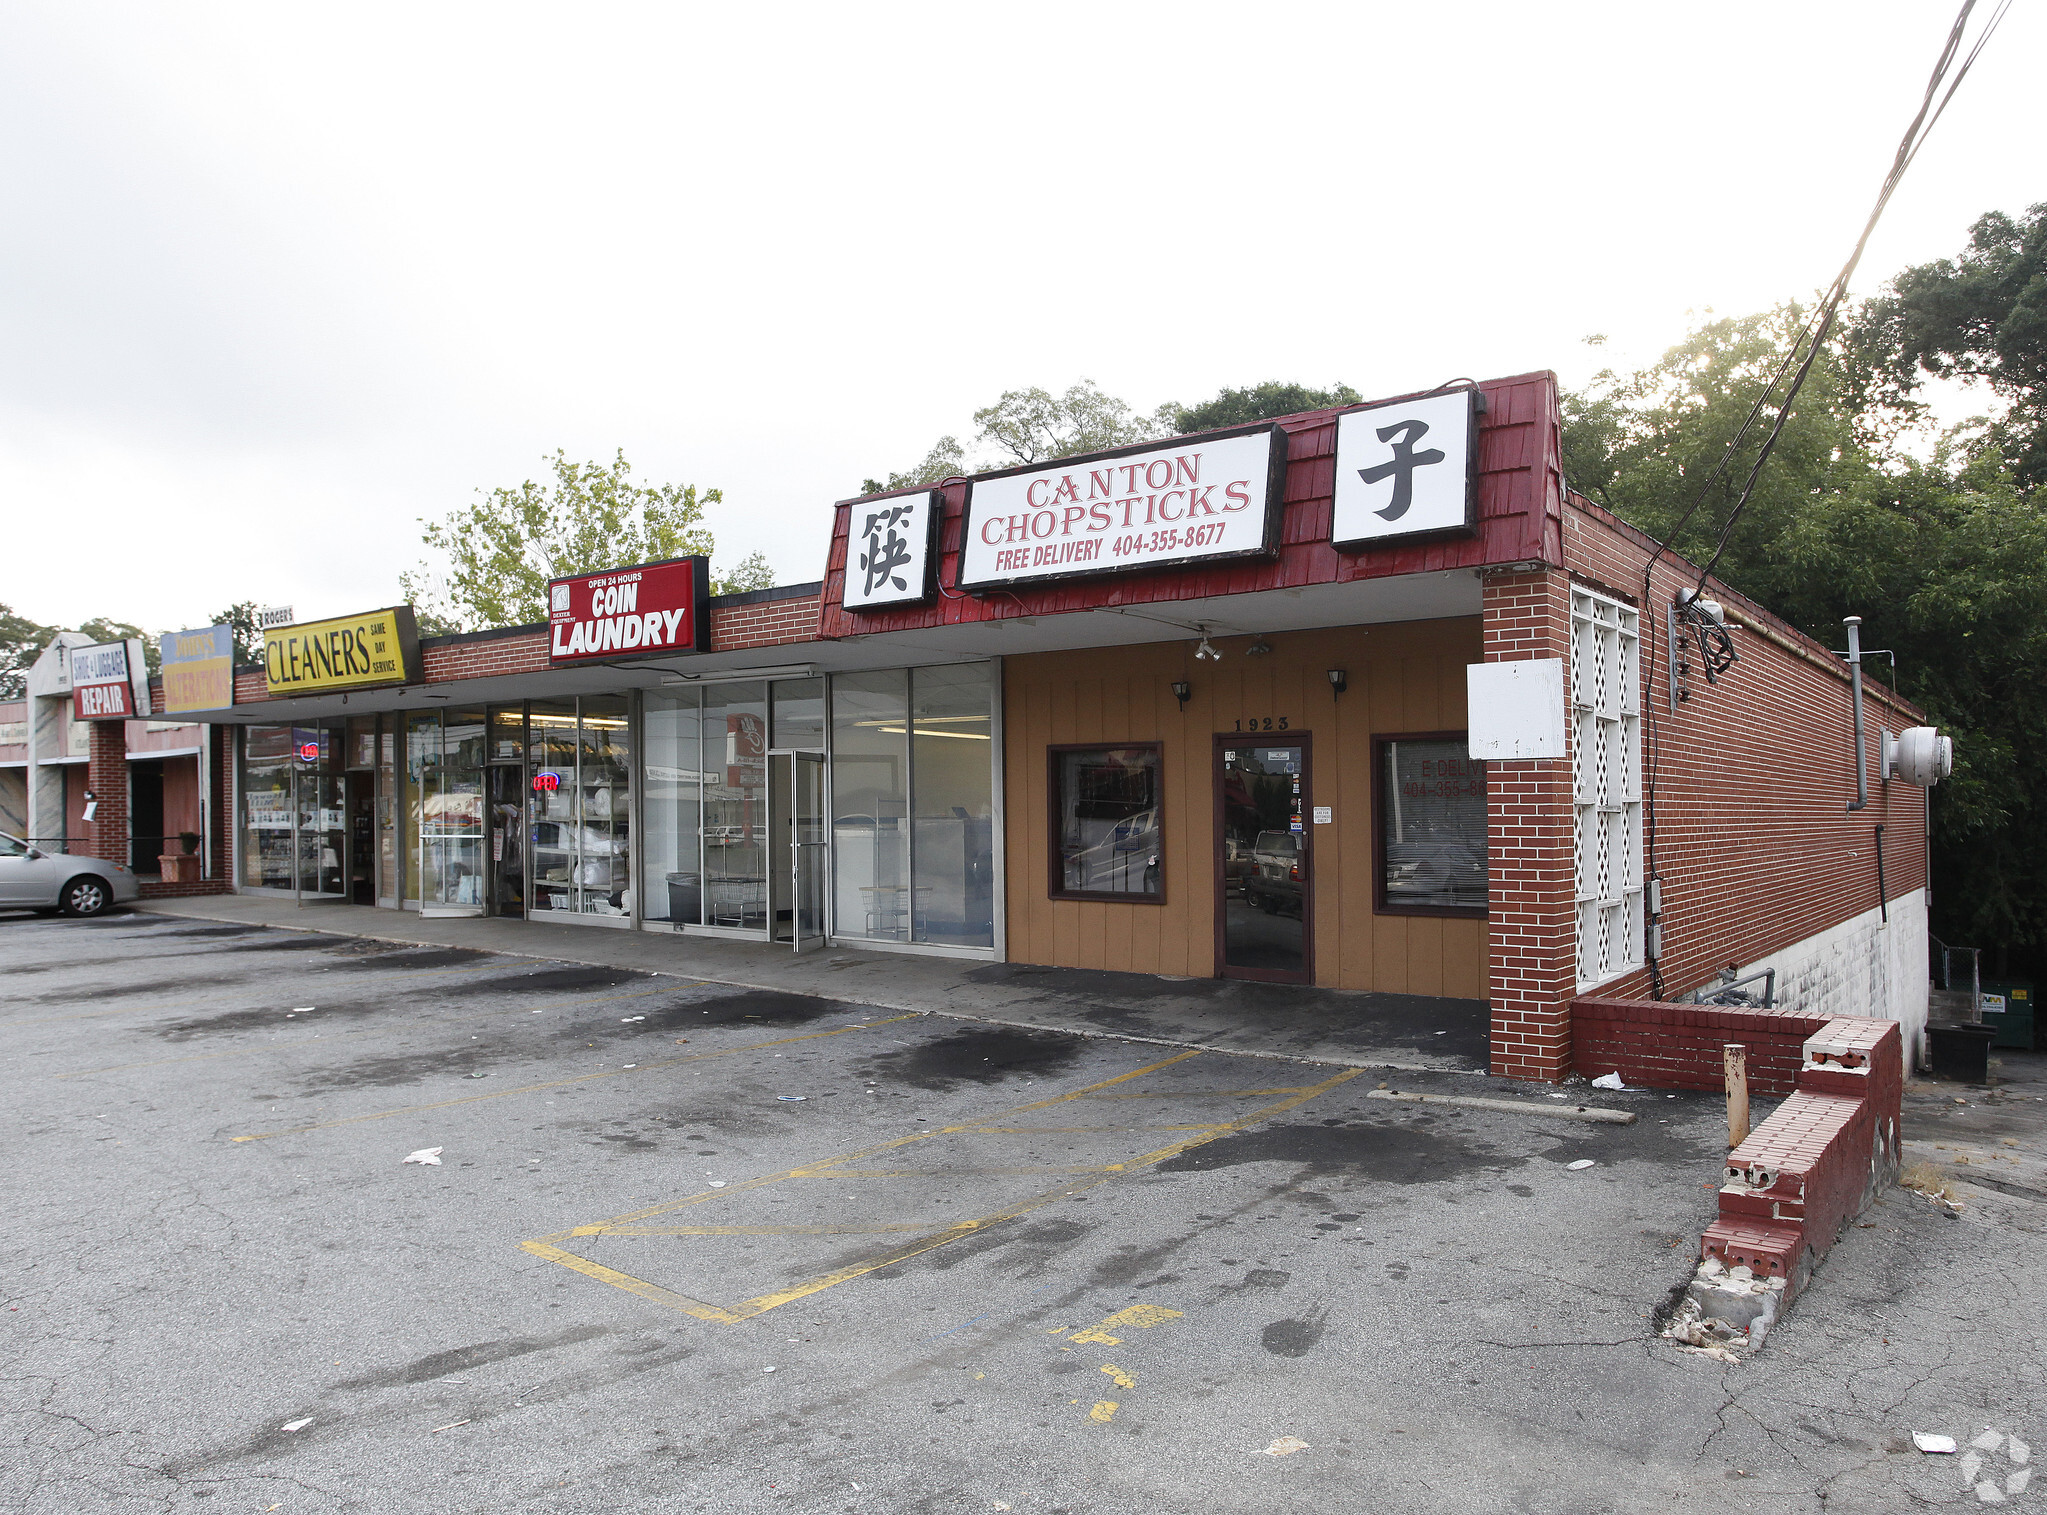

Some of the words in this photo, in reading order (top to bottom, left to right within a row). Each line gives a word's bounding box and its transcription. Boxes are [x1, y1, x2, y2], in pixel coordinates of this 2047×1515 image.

[1026, 452, 1203, 509] CANTON
[1357, 419, 1446, 522] 子
[981, 479, 1252, 546] CHOPSTICKS
[860, 505, 914, 597] 筷
[995, 547, 1030, 572] FREE
[1033, 538, 1104, 567] DELIVERY
[1112, 522, 1227, 558] 404-355-8677
[588, 579, 607, 589] OPEN
[608, 577, 617, 586] 24
[617, 572, 643, 584] HOURS
[592, 582, 638, 618] COIN
[370, 622, 386, 636] SAME
[552, 608, 685, 657] LAUNDRY
[94, 650, 125, 678] LUGGAGE
[266, 626, 371, 685] CLEANERS
[374, 641, 386, 654] DAY
[372, 660, 396, 673] SERVICE
[81, 684, 125, 715] REPAIR
[1235, 716, 1289, 732] 1923
[533, 776, 558, 791] OPEN
